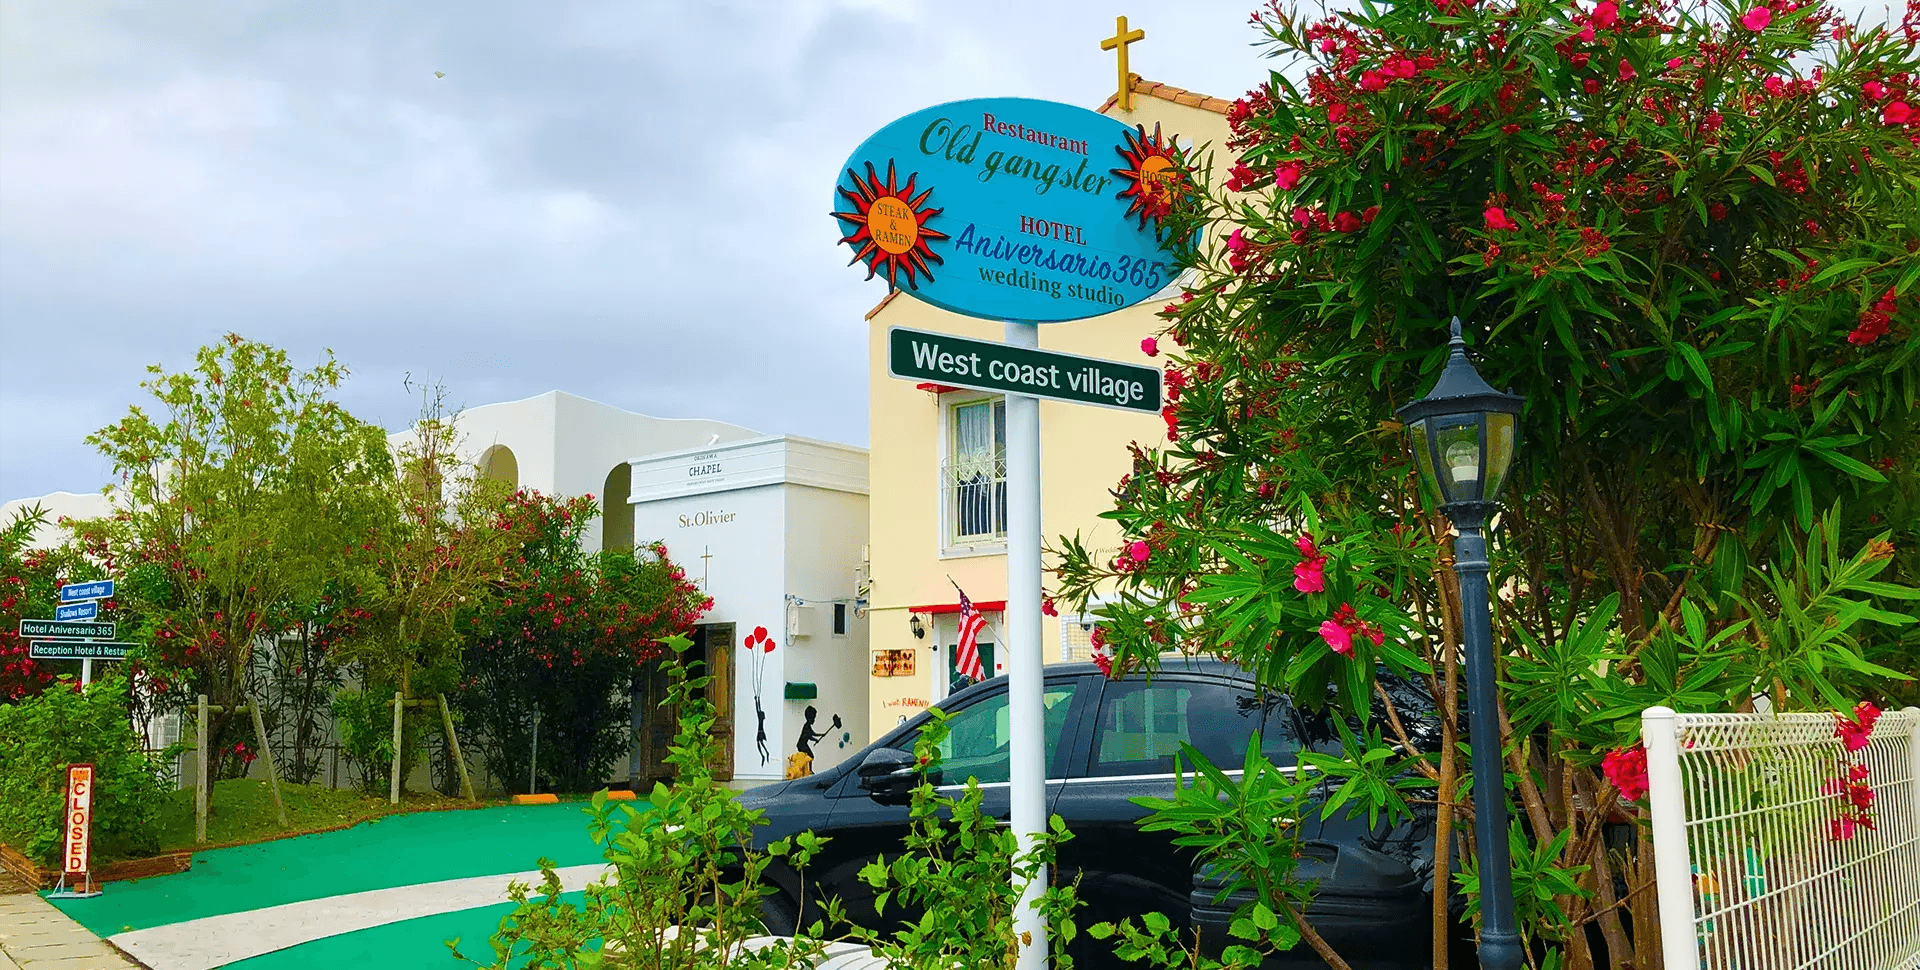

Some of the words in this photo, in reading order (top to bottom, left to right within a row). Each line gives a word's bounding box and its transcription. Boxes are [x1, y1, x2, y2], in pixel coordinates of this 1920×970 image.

[983, 112, 1089, 156] Restaurant
[918, 117, 983, 165] Old
[977, 149, 1112, 196] gangster
[877, 202, 910, 220] STEAK
[889, 219, 897, 231] &
[1020, 214, 1087, 246] HOTEL
[875, 229, 911, 248] RAMEN
[955, 223, 1166, 290] Aniversario365
[979, 265, 1062, 298] wedding
[1067, 281, 1125, 307] studio
[911, 340, 982, 377] West
[988, 359, 1061, 389] coast
[1066, 367, 1144, 405] village
[689, 463, 722, 476] CHAPEL
[678, 509, 736, 528] St.Olivier
[23, 624, 47, 634] Hotel
[48, 624, 96, 635] Aniversario
[97, 627, 113, 636] 365
[33, 644, 73, 656] Reception
[74, 645, 95, 655] Hotel
[96, 646, 102, 656] &
[104, 647, 128, 656] Resta
[70, 782, 86, 870] CLOSED
